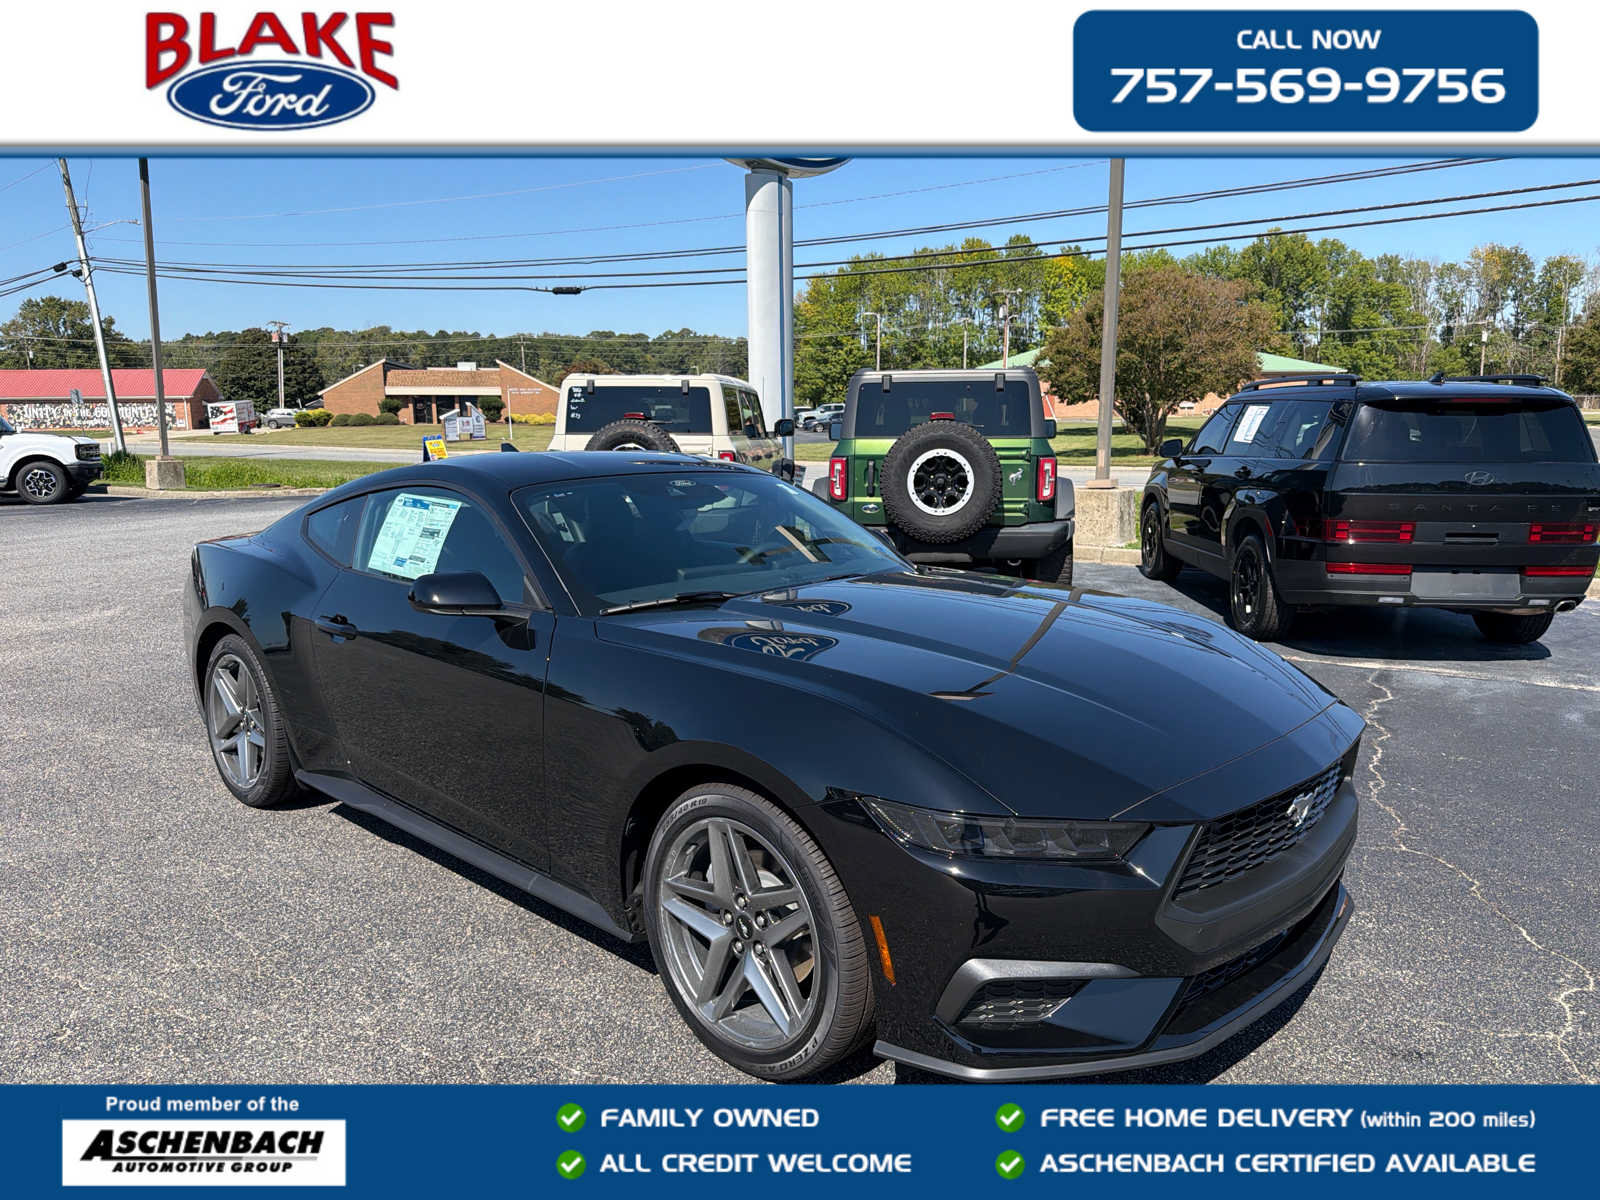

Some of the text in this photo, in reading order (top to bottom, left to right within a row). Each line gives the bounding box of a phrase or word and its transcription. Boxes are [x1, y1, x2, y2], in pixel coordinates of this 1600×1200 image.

[24, 405, 61, 419] UNITY
[1385, 503, 1561, 513] SANTA FE
[779, 1046, 812, 1070] ZERO
